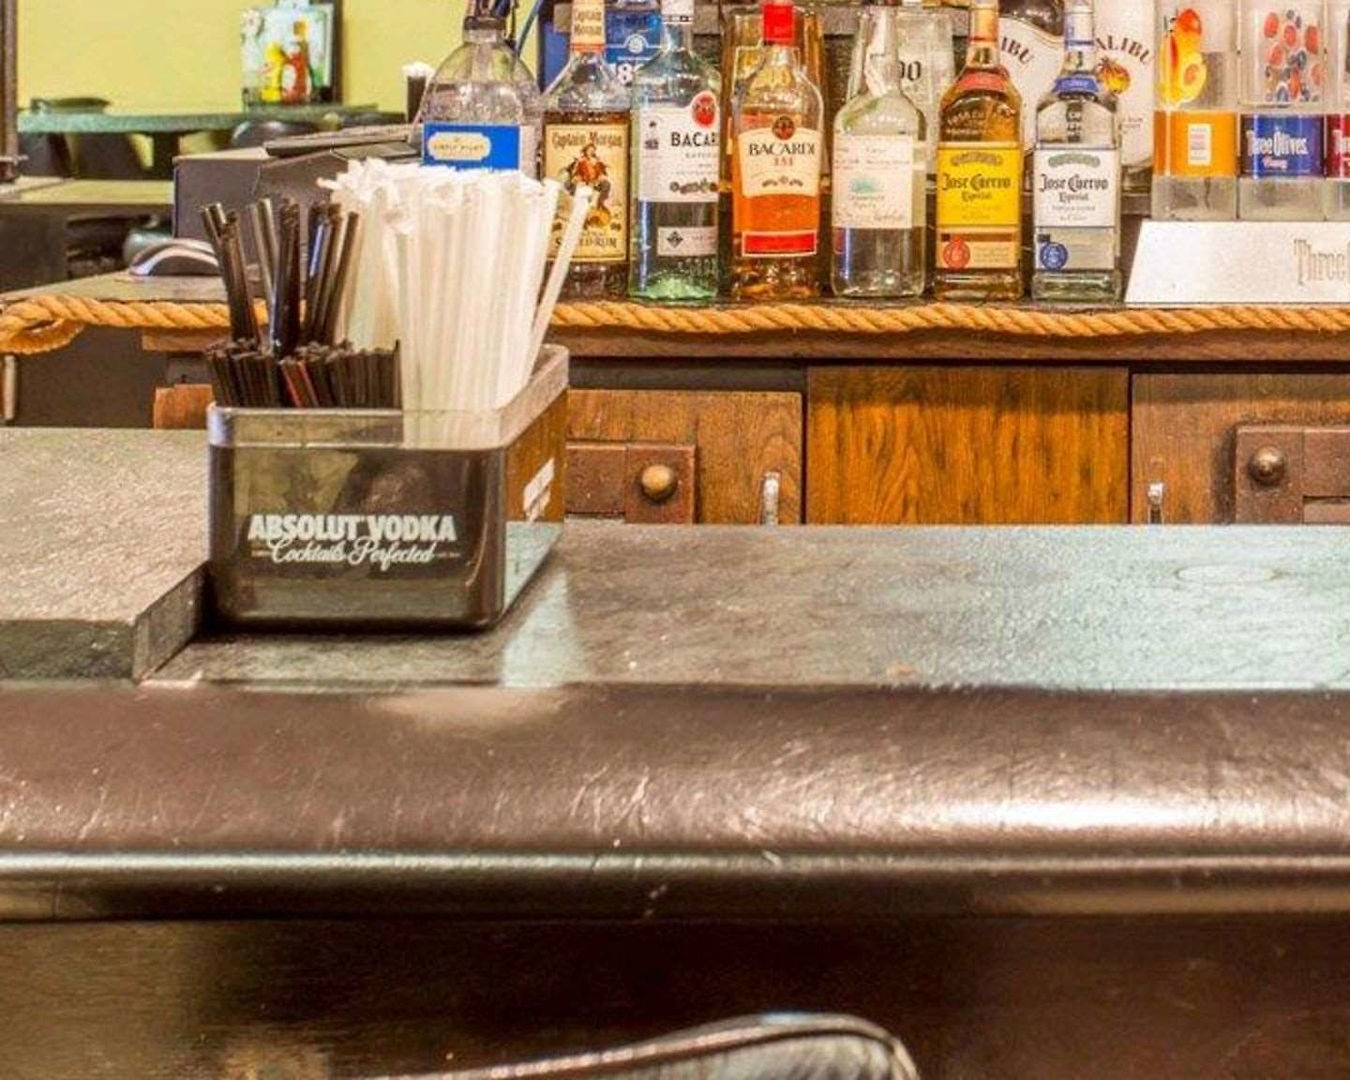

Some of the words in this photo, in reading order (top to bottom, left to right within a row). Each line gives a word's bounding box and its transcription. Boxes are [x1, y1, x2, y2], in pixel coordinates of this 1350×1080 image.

[1000, 36, 1034, 66] IBU
[671, 131, 719, 147] BACAR
[749, 142, 816, 156] BACARDI
[942, 172, 969, 191] Jose
[969, 172, 1011, 192] Cuervo
[1039, 173, 1066, 192] Jose
[1067, 173, 1109, 192] Cuervo
[1293, 238, 1345, 285] Three
[247, 515, 361, 540] ABSOLUT
[367, 514, 457, 541] VODKA
[269, 536, 347, 563] Cocktails
[349, 536, 437, 572] Perfected
